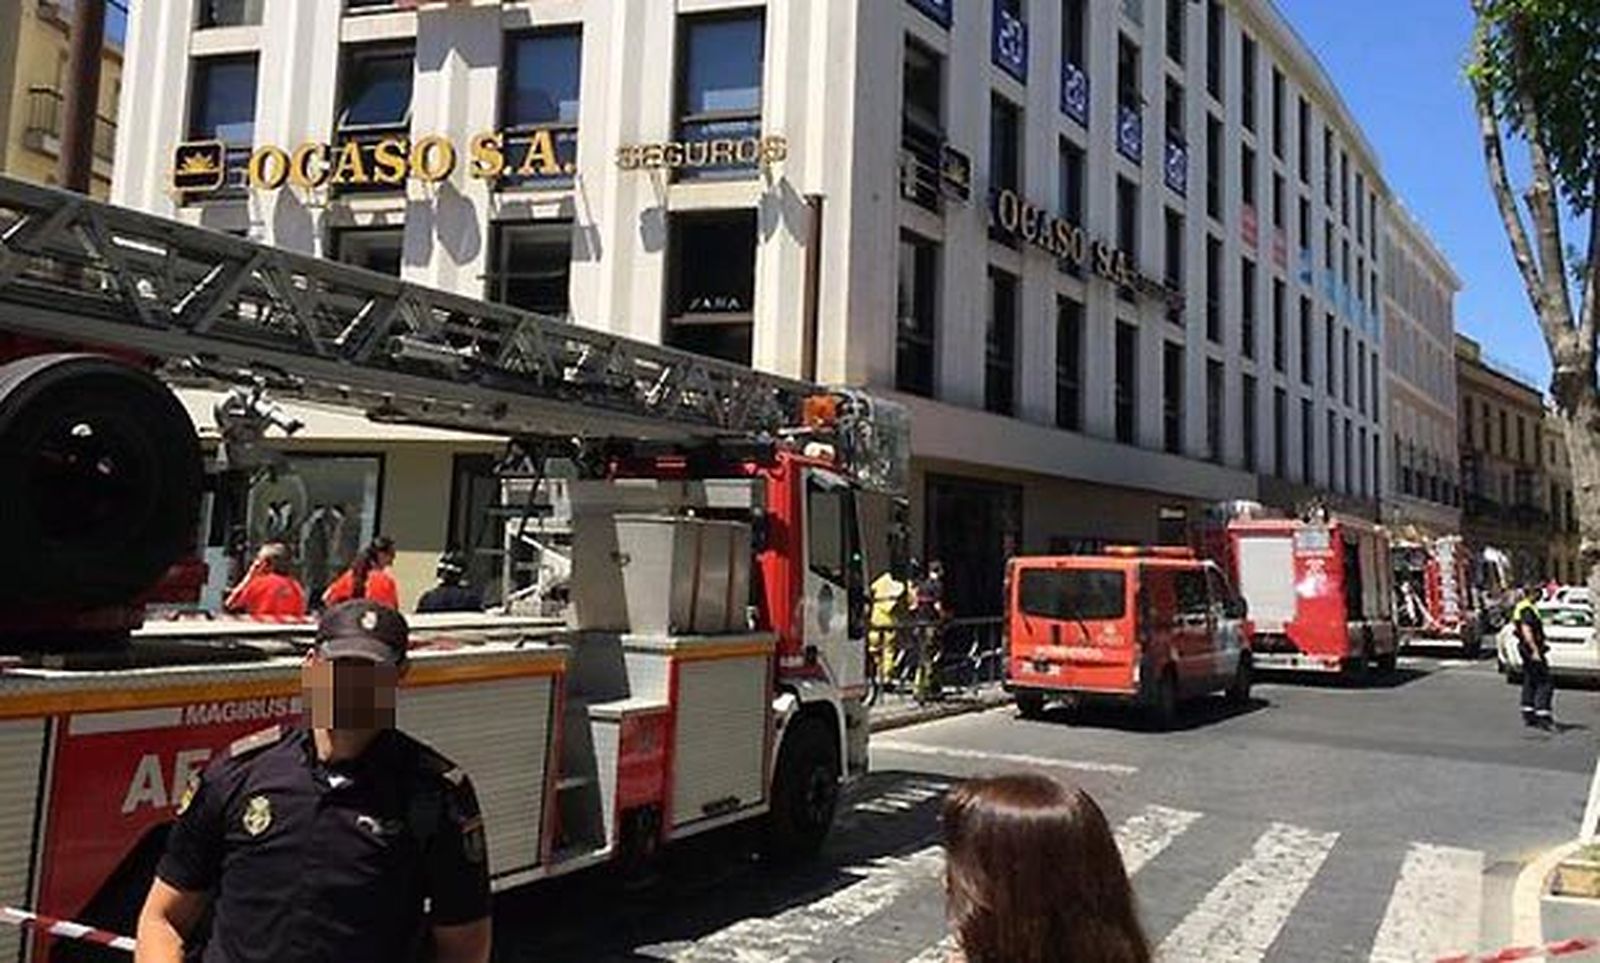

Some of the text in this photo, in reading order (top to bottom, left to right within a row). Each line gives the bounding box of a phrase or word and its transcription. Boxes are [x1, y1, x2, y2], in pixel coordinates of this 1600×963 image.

[248, 127, 577, 189] OCASO S.A.
[616, 134, 788, 171] SEGUROS
[999, 188, 1085, 266] OCASO
[184, 696, 288, 726] MAGIRUS
